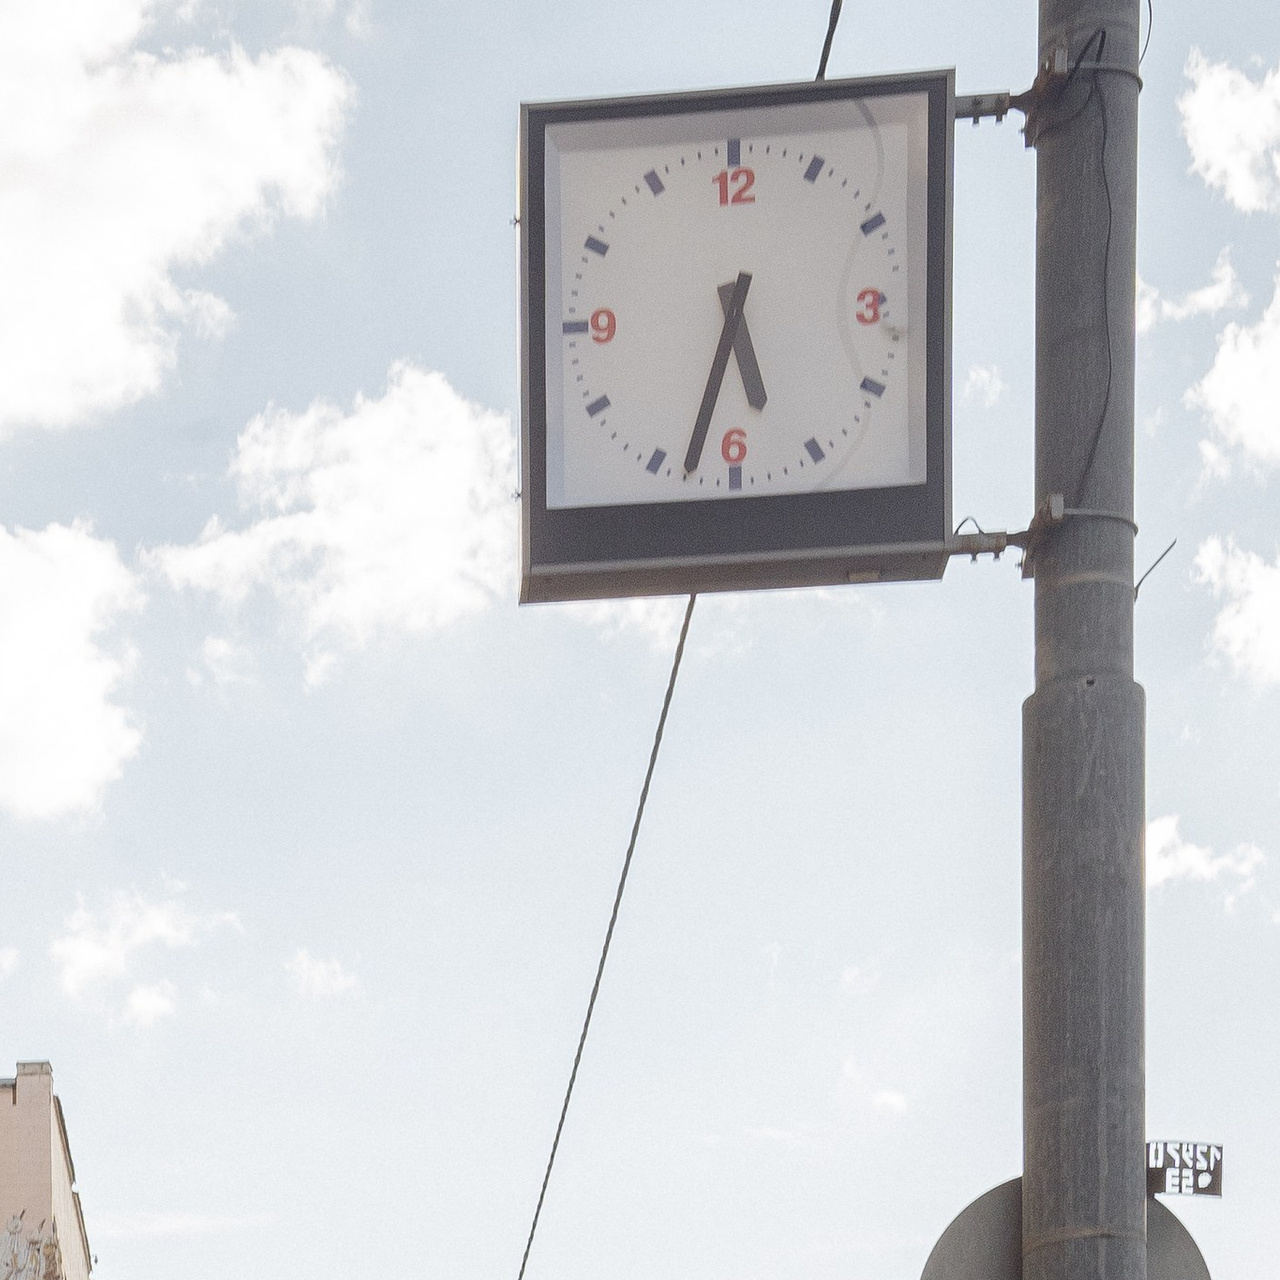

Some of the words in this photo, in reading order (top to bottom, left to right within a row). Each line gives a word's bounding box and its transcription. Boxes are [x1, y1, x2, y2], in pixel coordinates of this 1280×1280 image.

[711, 167, 756, 206] 12
[855, 288, 881, 326] 3
[589, 308, 617, 344] 9
[721, 428, 748, 464] 6
